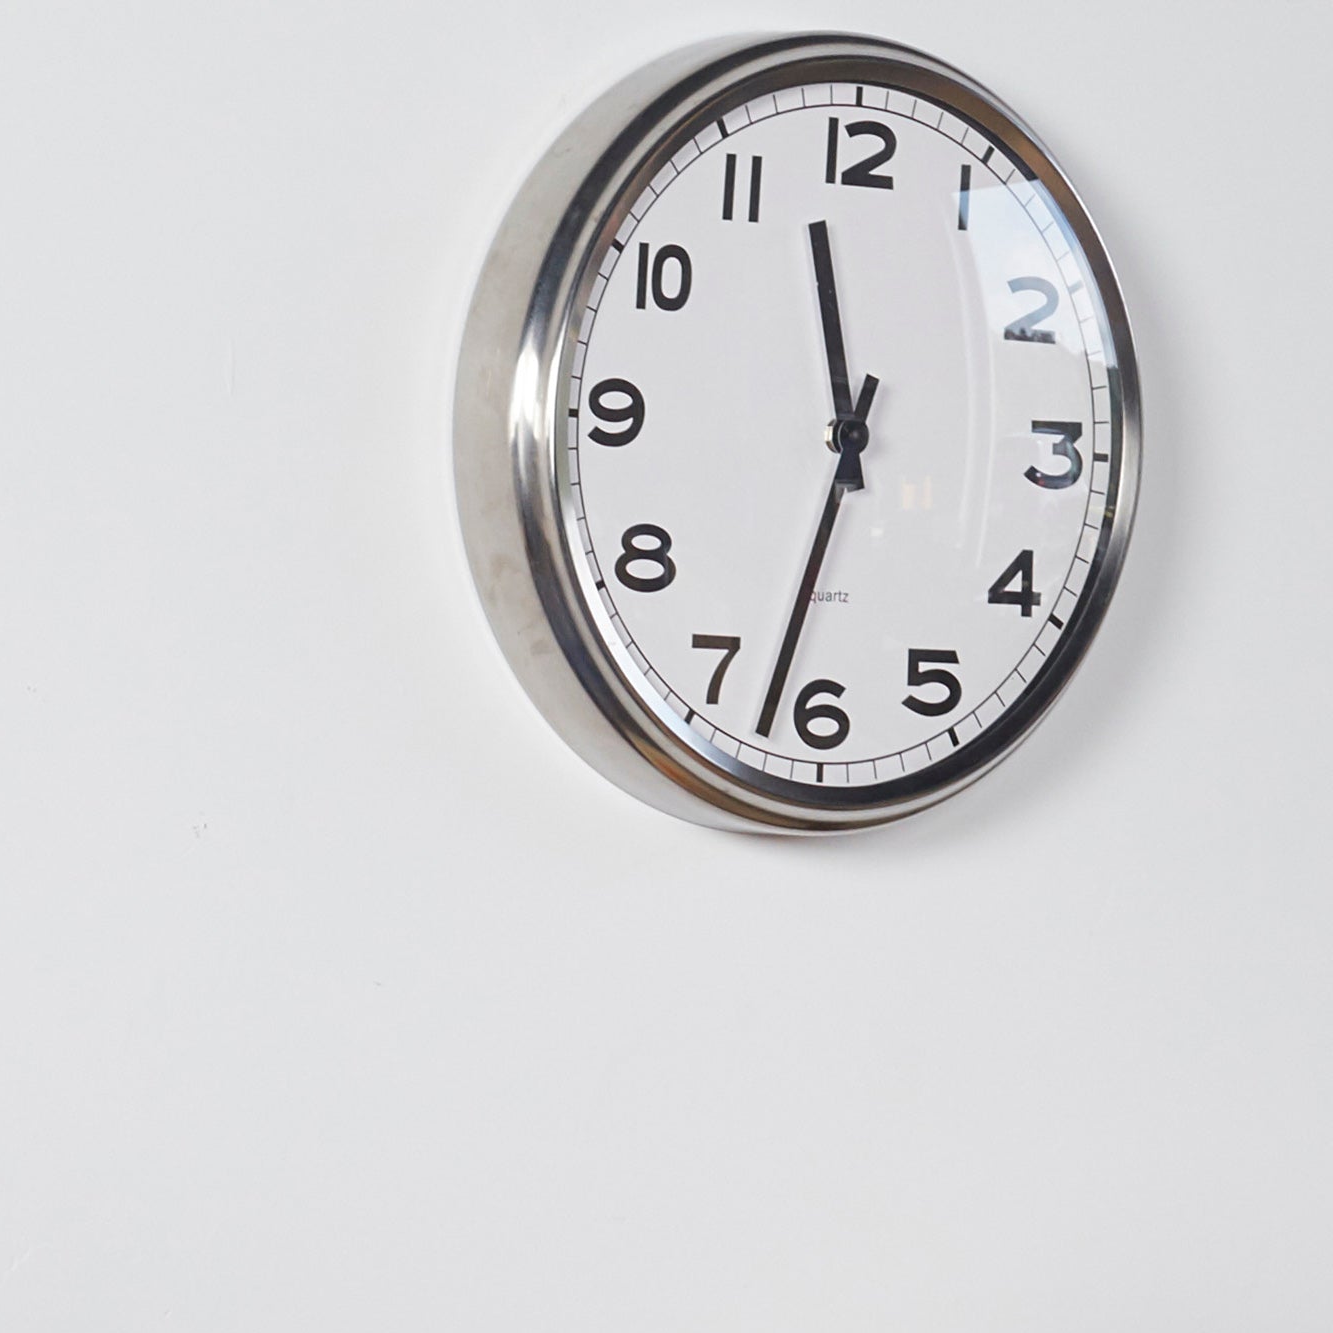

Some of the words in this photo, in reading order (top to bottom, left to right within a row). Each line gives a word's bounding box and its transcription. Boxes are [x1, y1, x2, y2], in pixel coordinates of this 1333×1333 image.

[722, 153, 763, 223] 11
[826, 117, 897, 191] 12
[957, 164, 972, 231] 1
[635, 242, 693, 312] 10
[1003, 277, 1061, 345] 2
[587, 378, 646, 447] 9
[1023, 420, 1083, 490] 3
[614, 523, 677, 593] 8
[987, 549, 1042, 618] 4
[810, 590, 850, 604] quartz
[691, 634, 741, 705] 7
[901, 648, 963, 718] 5
[793, 679, 851, 750] 6
